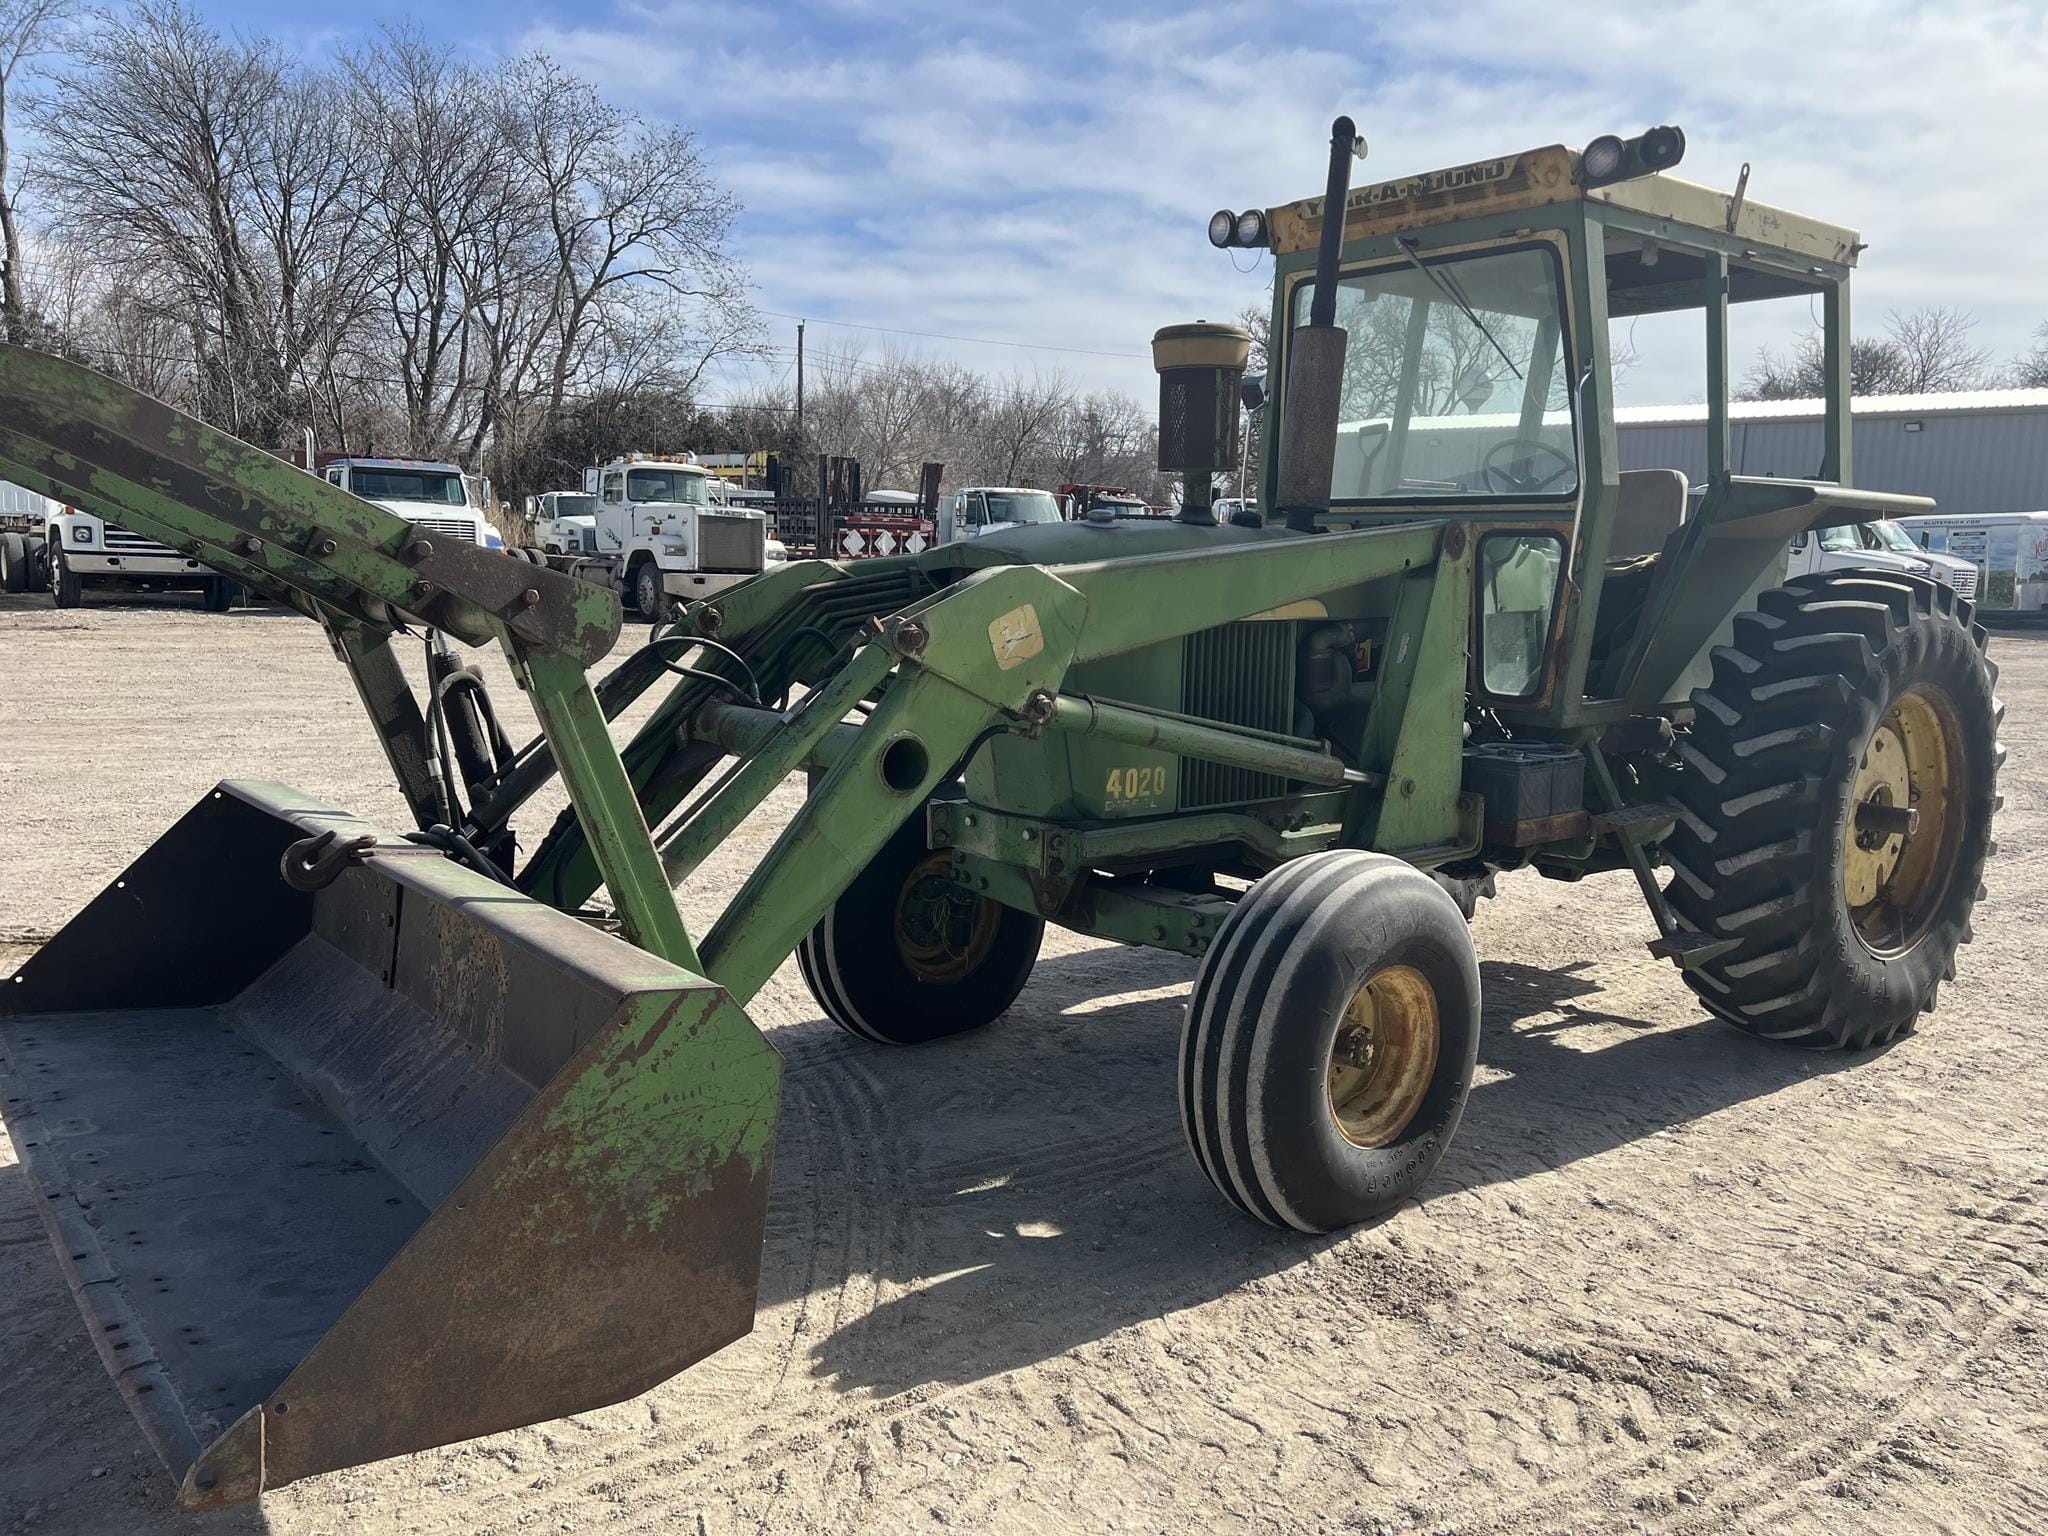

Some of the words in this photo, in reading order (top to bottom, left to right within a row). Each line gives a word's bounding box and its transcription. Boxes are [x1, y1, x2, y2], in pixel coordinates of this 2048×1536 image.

[1308, 161, 1505, 216] YR-A-ROUND
[714, 509, 748, 518] MACK
[1106, 766, 1165, 798] 4020
